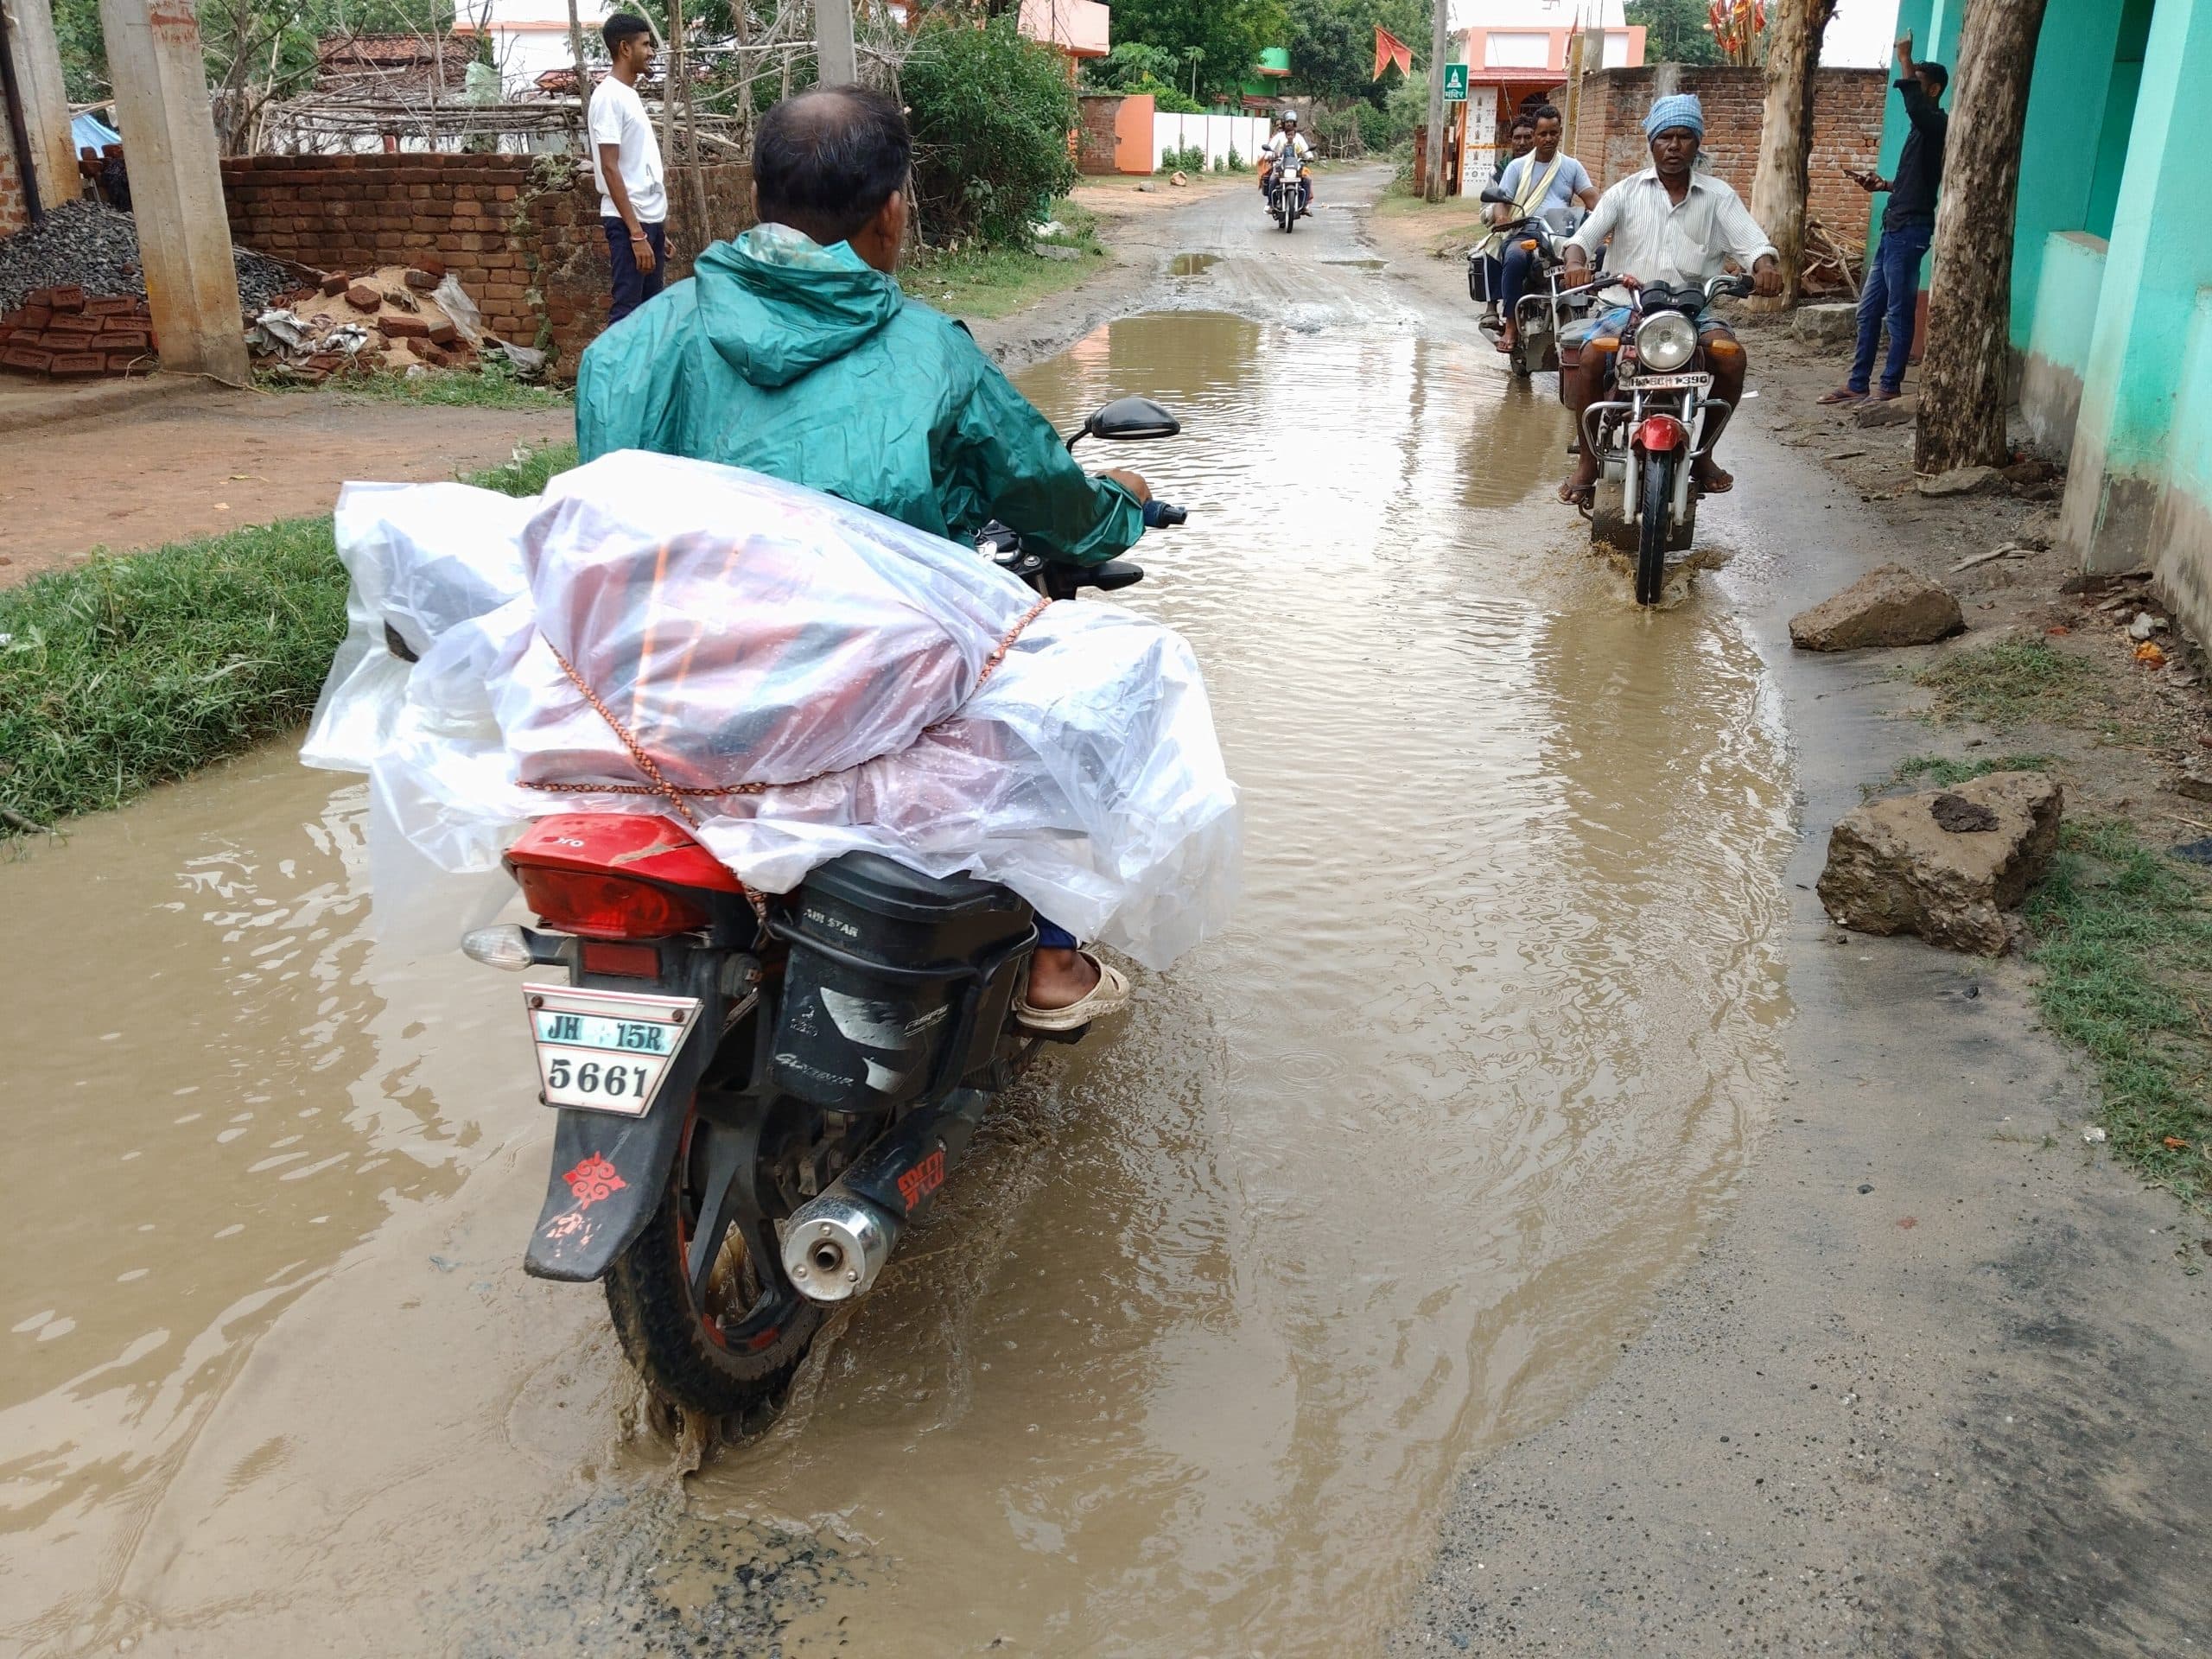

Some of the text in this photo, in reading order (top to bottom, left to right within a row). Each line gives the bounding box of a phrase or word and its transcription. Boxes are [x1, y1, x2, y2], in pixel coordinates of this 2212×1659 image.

[1445, 88, 1465, 99] मंदिर
[548, 1015, 663, 1052] JH 15R
[548, 1058, 648, 1098] 5661
